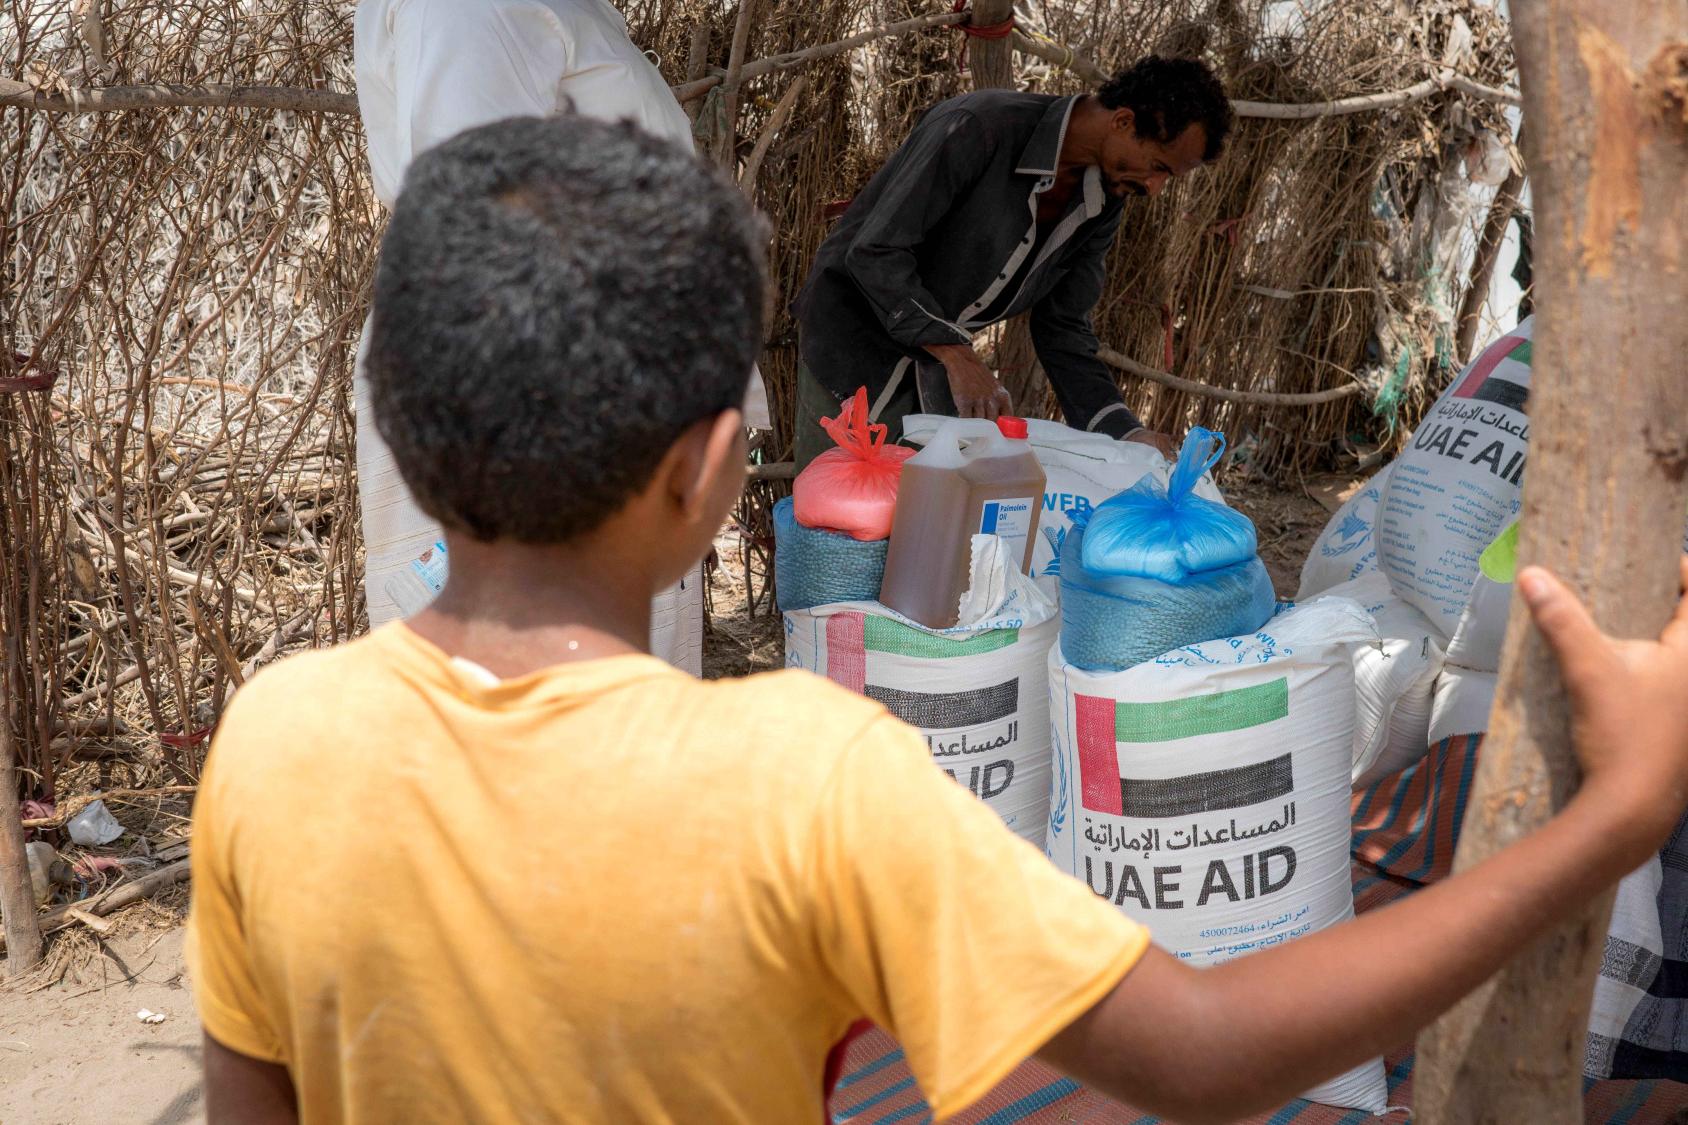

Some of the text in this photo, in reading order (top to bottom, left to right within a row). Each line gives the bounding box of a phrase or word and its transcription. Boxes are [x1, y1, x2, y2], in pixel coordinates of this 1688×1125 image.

[1414, 422, 1479, 460] UAE
[1000, 503, 1027, 512] Palmolein
[928, 720, 1017, 757] المساعدا
[1085, 802, 1296, 859] المساعدات الإماراتية
[1085, 845, 1297, 910] UAE AID
[1200, 924, 1255, 938] 4500072464
